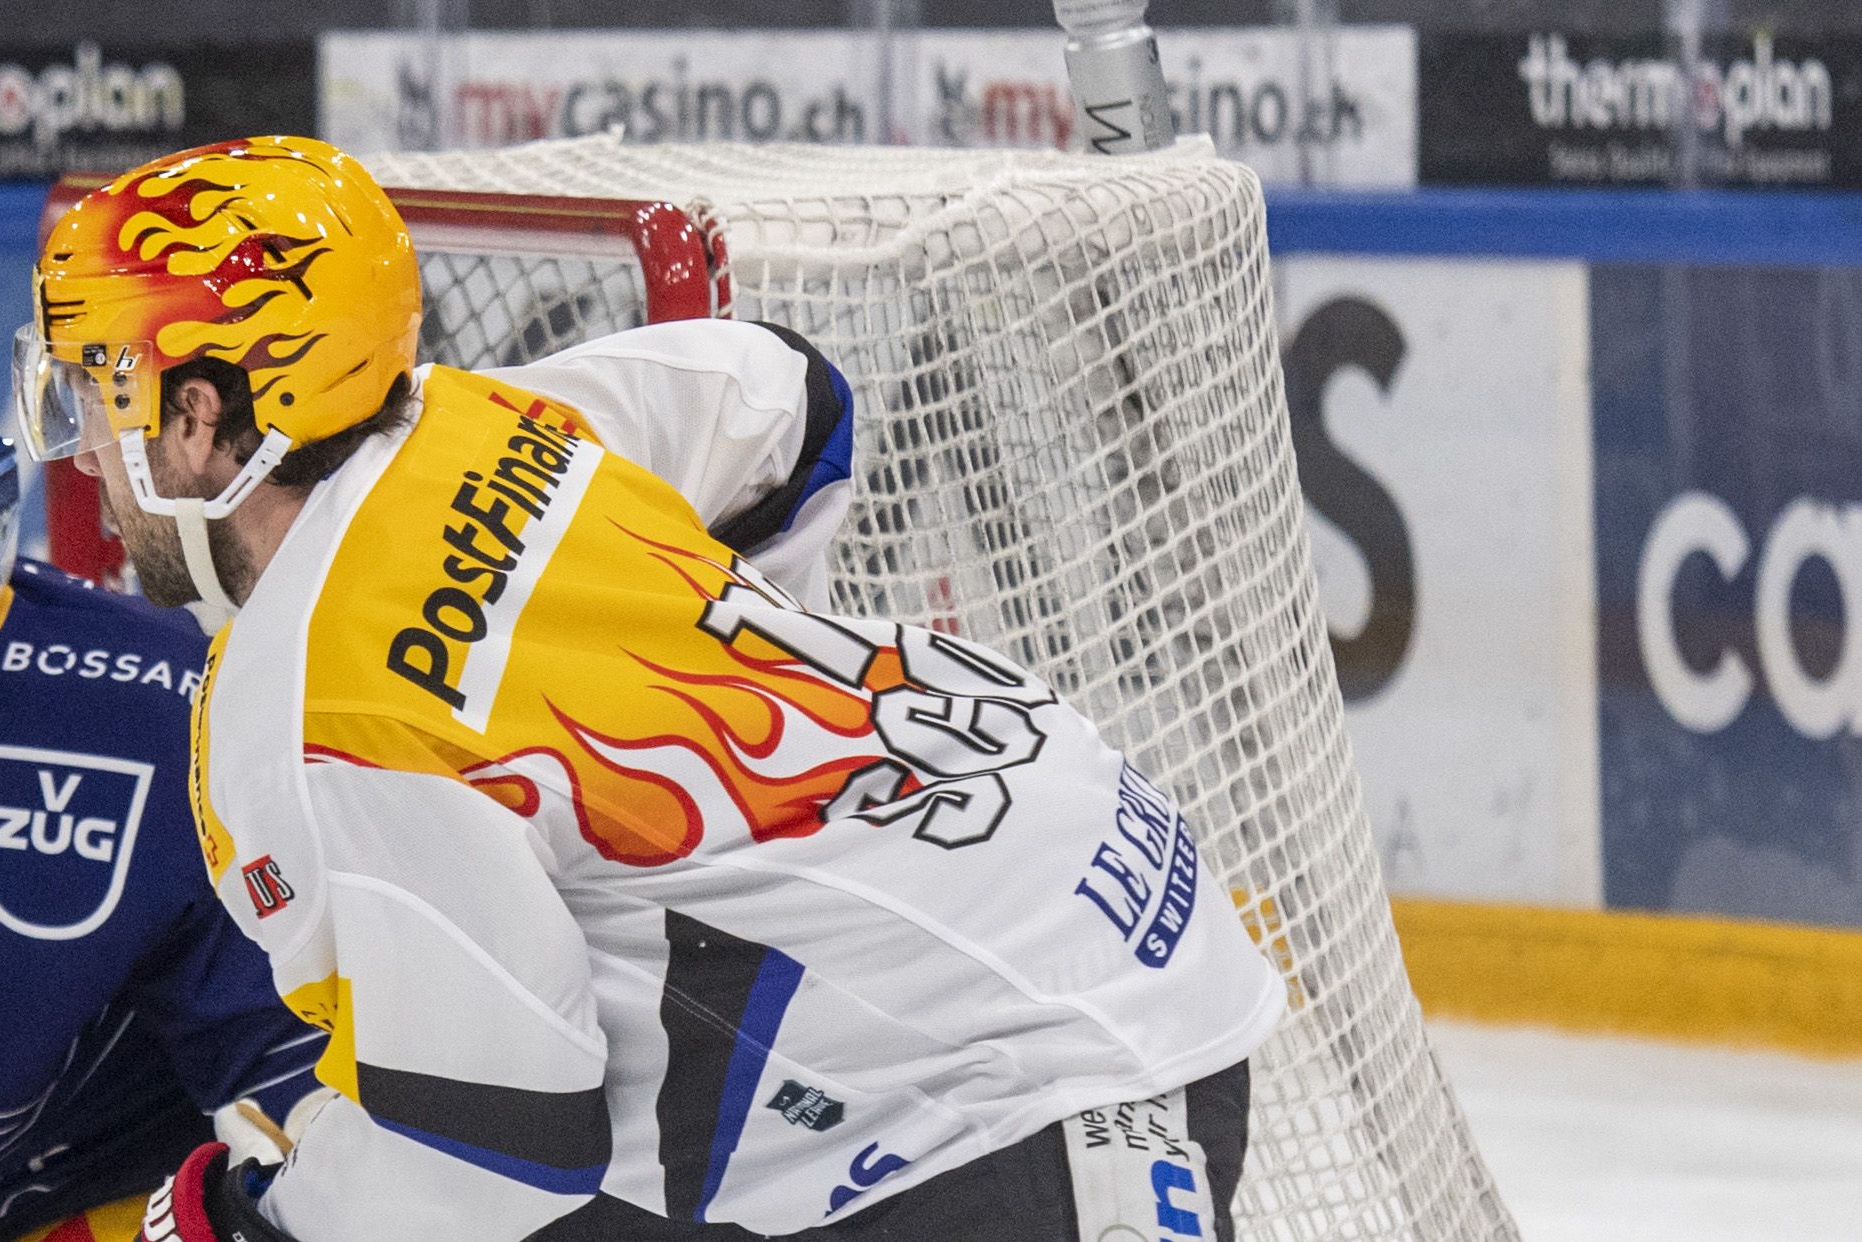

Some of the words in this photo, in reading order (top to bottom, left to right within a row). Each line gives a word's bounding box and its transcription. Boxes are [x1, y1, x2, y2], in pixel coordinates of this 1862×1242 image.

[455, 52, 865, 142] mycasino.ch
[1518, 32, 1832, 149] thermoplan
[1074, 842, 1152, 943] LE
